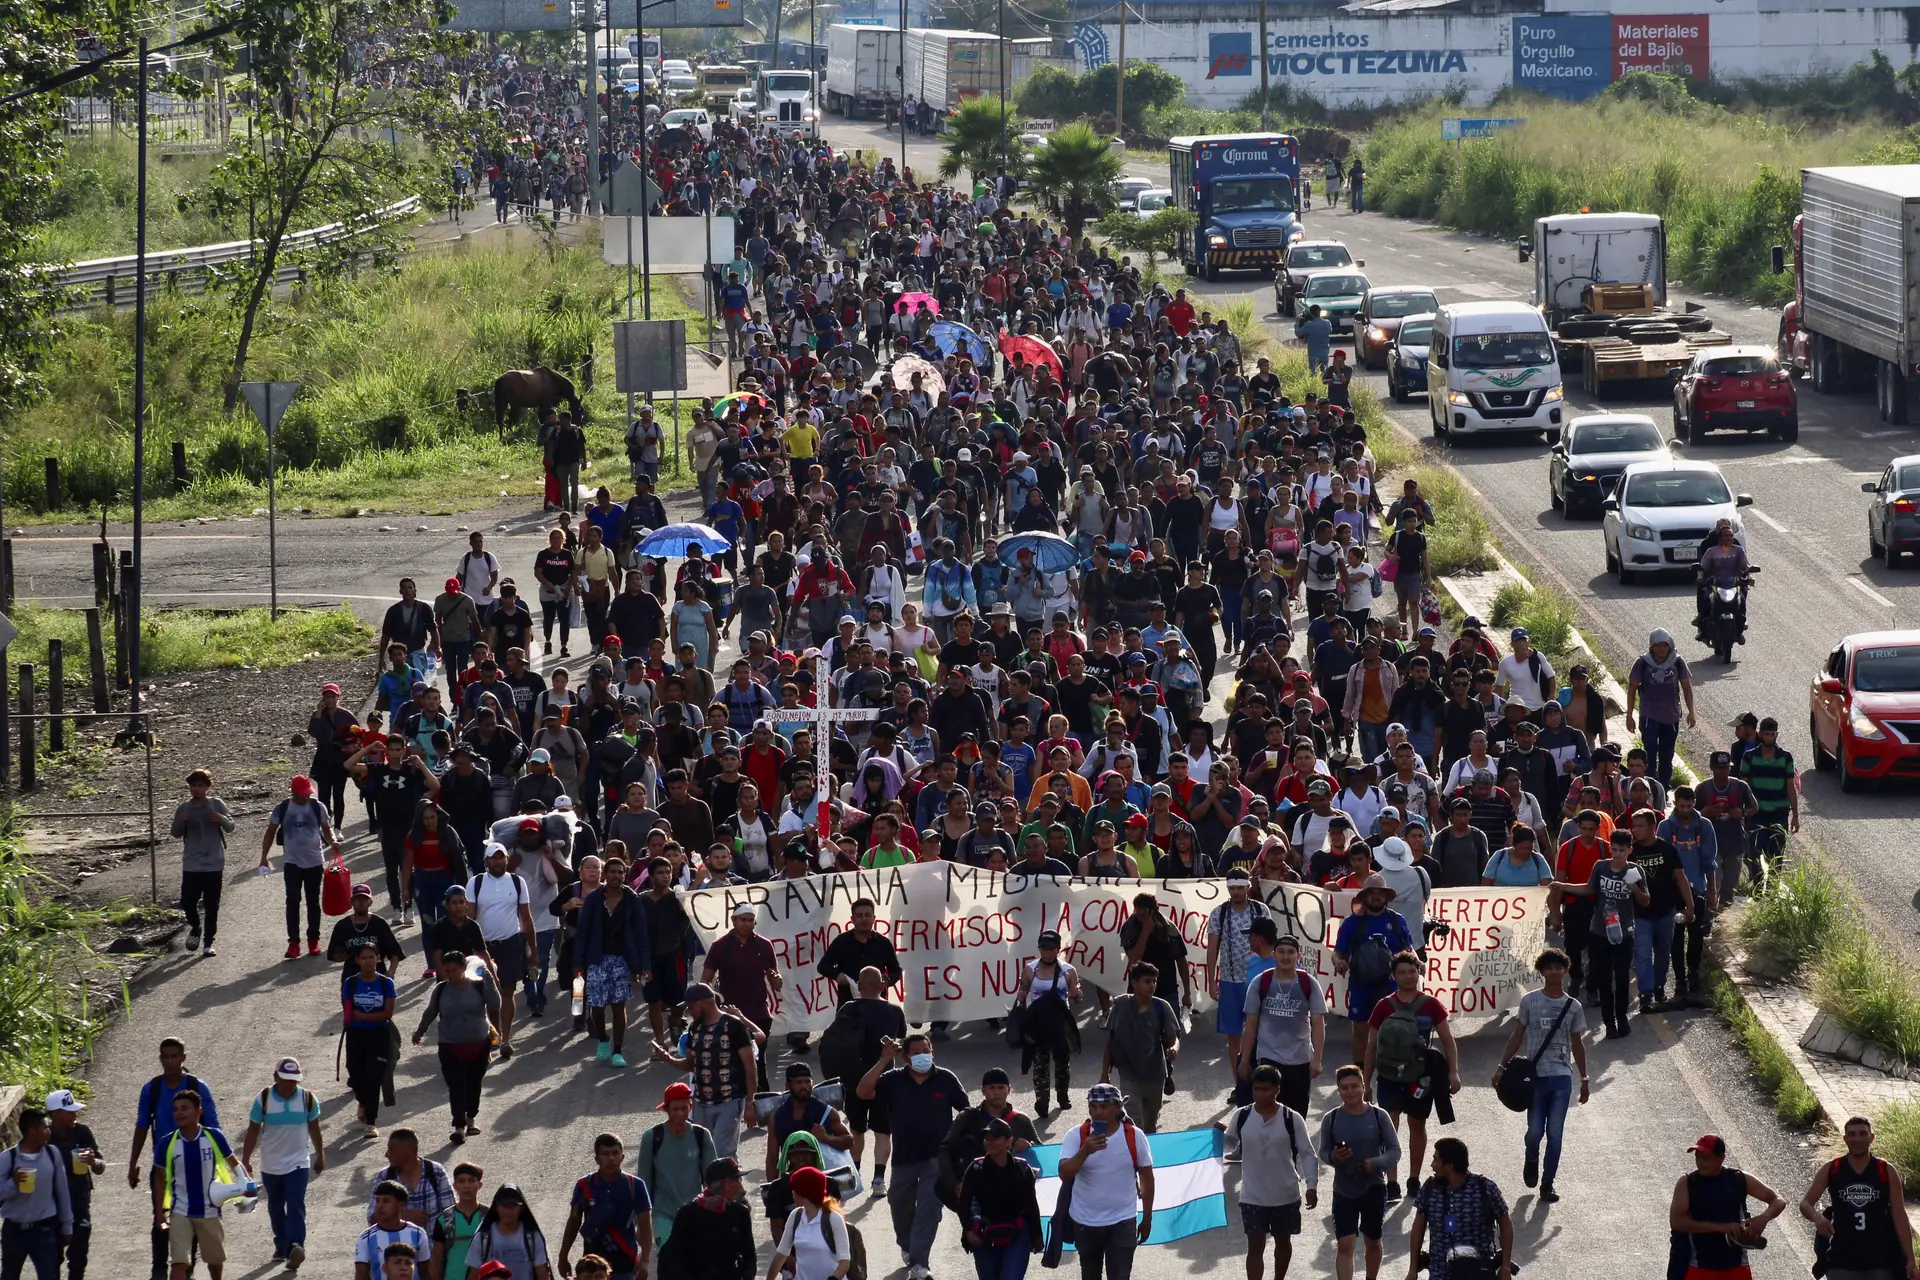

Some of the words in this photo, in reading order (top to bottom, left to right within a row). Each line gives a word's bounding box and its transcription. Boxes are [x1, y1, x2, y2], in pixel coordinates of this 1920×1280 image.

[1519, 25, 1556, 40] Puro
[1618, 24, 1699, 39] Materiales
[1266, 32, 1369, 48] Cementos
[1520, 45, 1575, 63] Orgullo
[1618, 43, 1642, 57] del
[1267, 50, 1468, 76] MOCTEZUMA
[1222, 148, 1269, 165] Corona
[1868, 649, 1898, 660] TRIKI
[1637, 856, 1665, 868] GUESS
[690, 863, 909, 930] CARAVANA
[1511, 918, 1545, 936] CUBA
[1469, 955, 1538, 977] VENEZUELA
[923, 964, 963, 1001] ES
[1268, 1009, 1295, 1018] BASEBALL
[201, 1147, 212, 1160] H
[1854, 1211, 1866, 1231] 3
